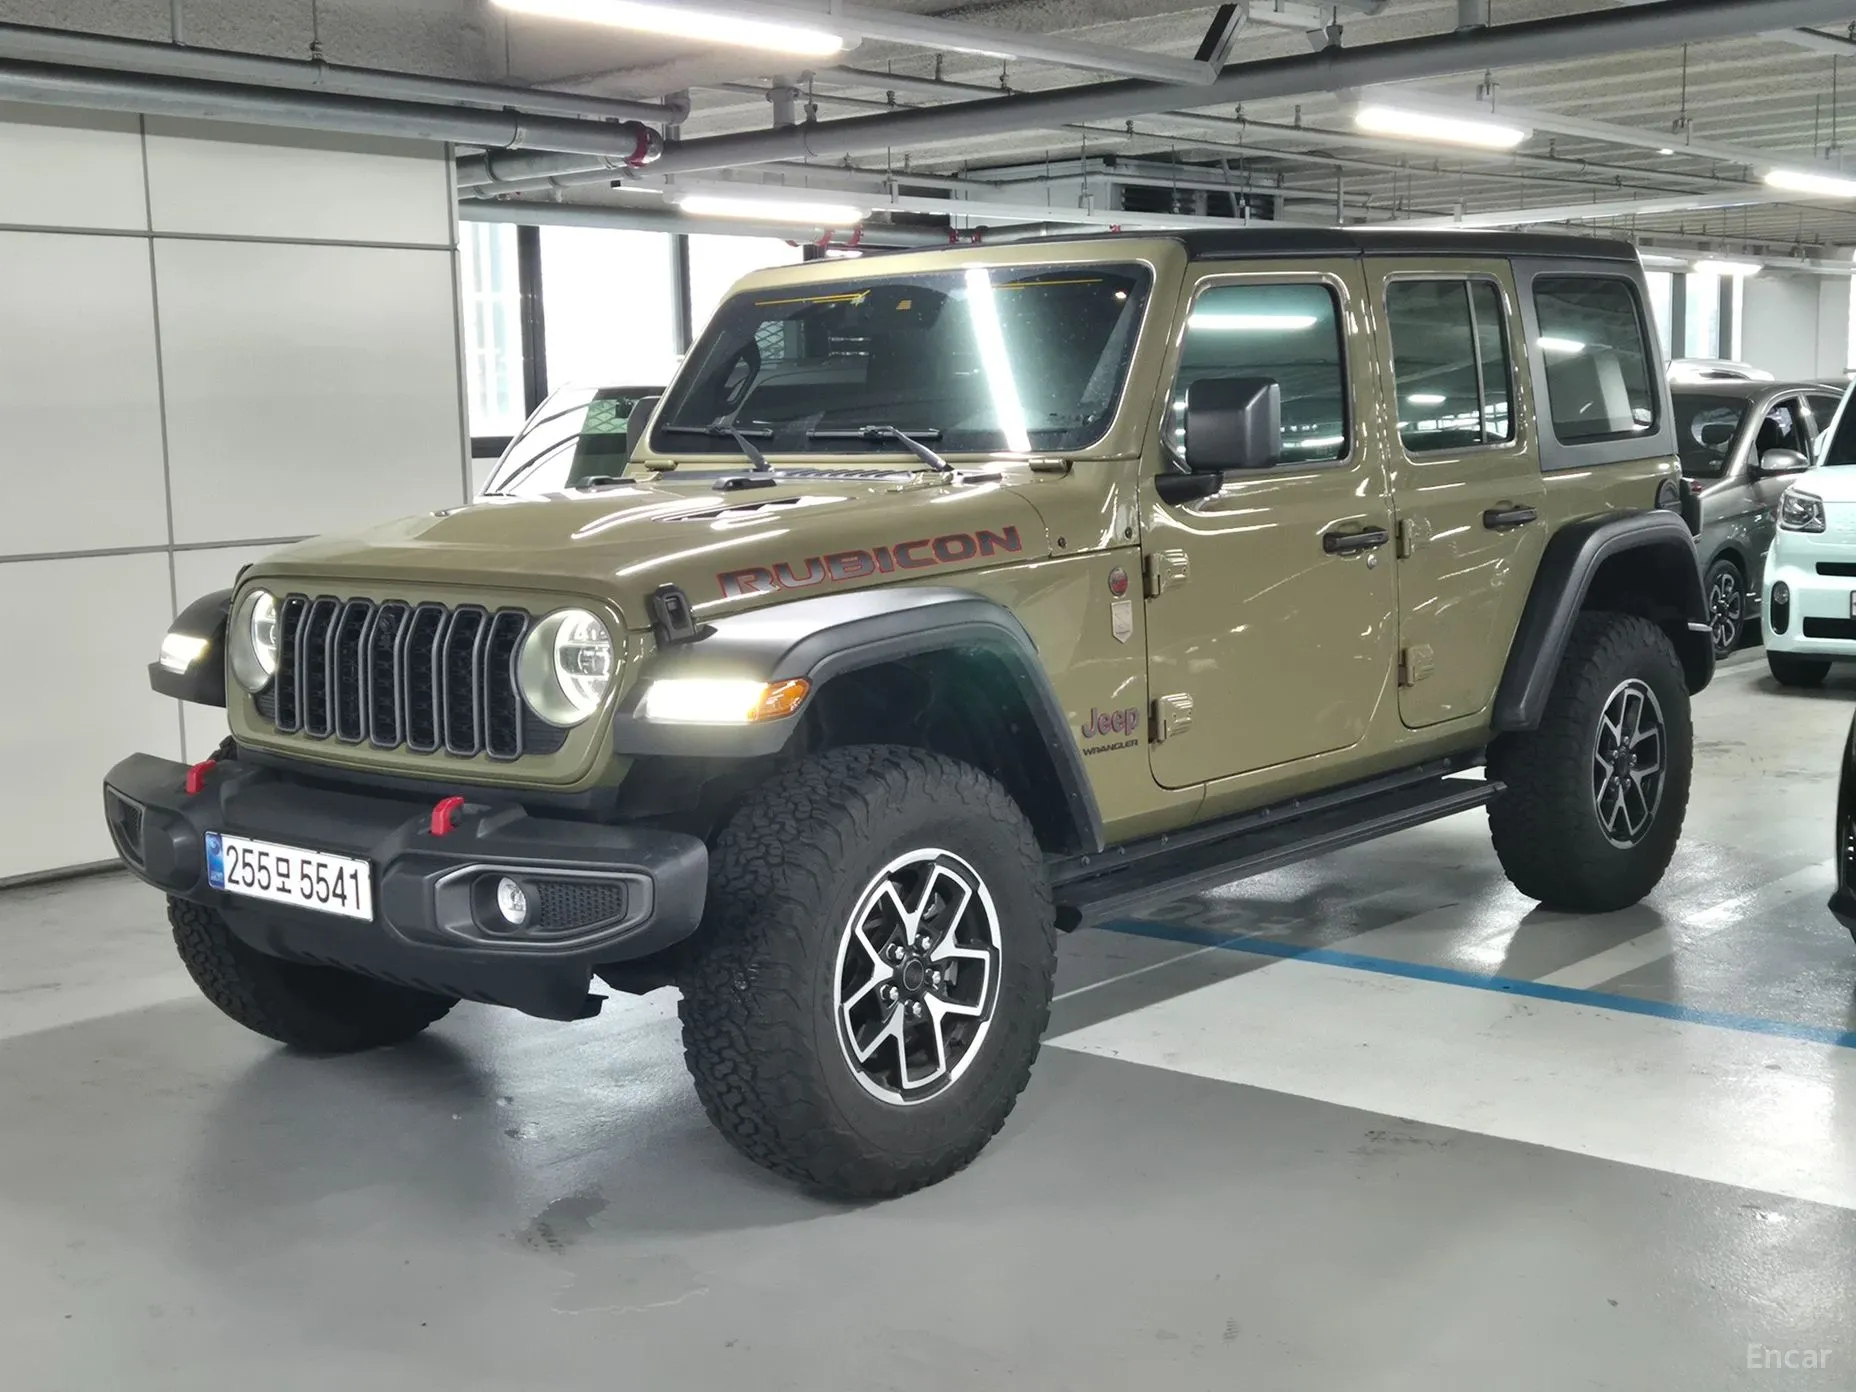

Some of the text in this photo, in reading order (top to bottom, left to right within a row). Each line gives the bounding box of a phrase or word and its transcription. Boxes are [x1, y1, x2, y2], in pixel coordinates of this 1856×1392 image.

[716, 525, 1023, 599] RUBICON
[1081, 707, 1139, 738] Jeep
[1082, 739, 1138, 756] WRANGLER
[226, 845, 361, 910] 255모 5541
